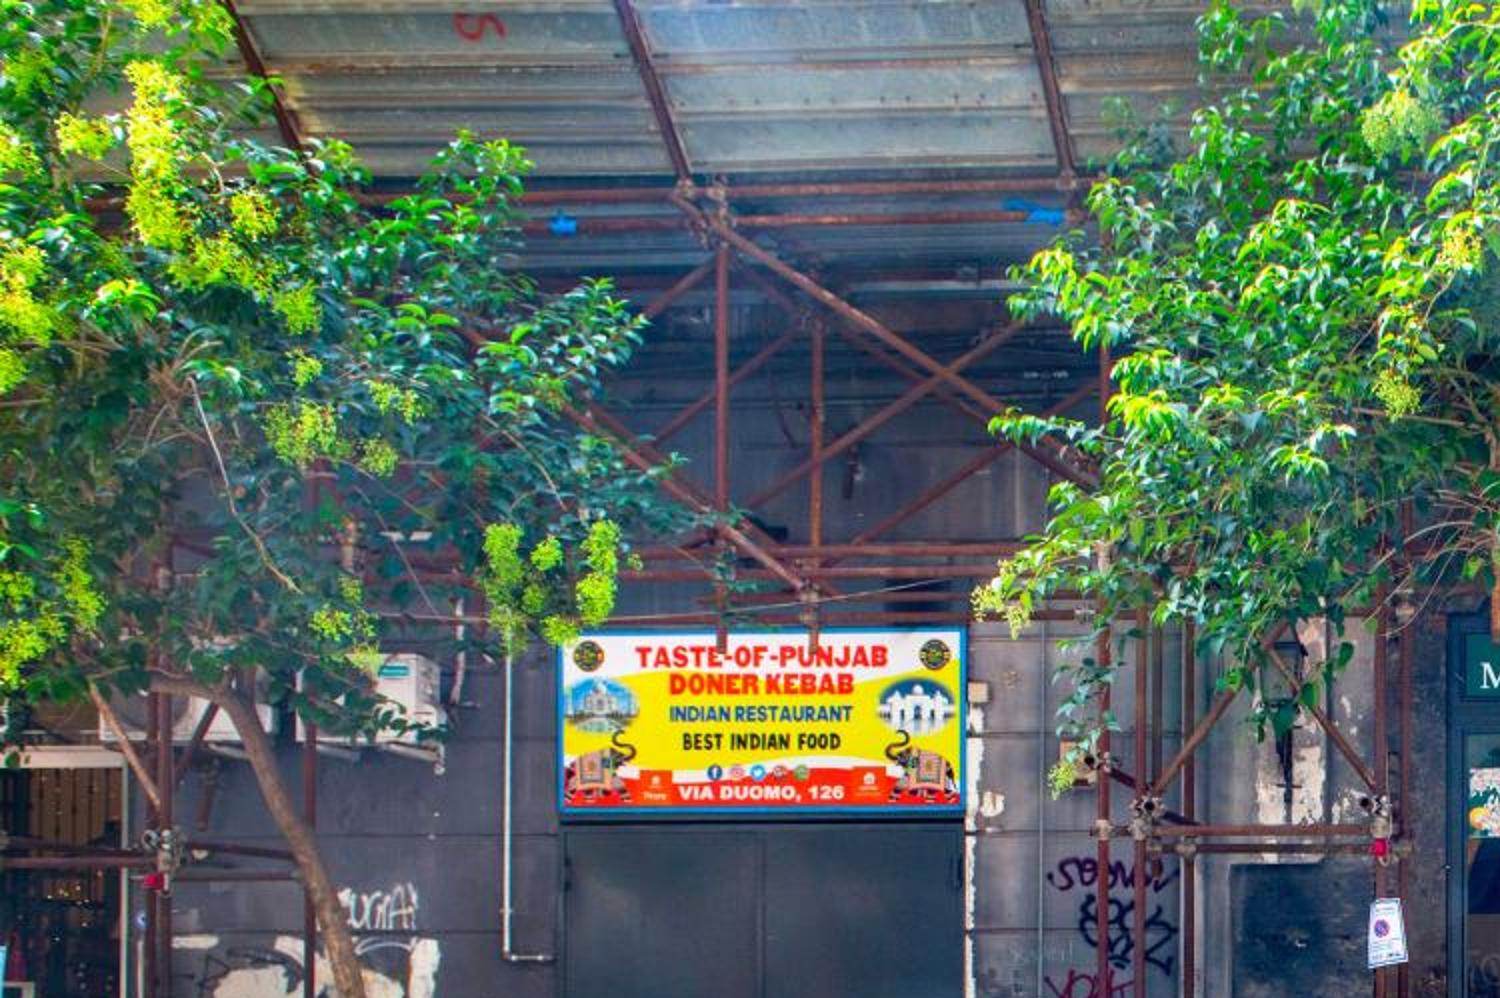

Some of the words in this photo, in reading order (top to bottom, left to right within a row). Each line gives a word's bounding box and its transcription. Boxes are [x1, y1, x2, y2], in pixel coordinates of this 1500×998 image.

[635, 646, 888, 668] TASTE-OF-PUNJAB
[669, 673, 759, 695] DONER
[765, 673, 854, 695] KEBAB
[669, 706, 730, 721] INDIAN
[735, 706, 853, 721] RESTAURANT
[682, 733, 723, 750] BEST
[730, 733, 790, 750] INDIAN
[797, 733, 841, 750] FOOD
[679, 786, 713, 800] VIA
[719, 786, 802, 803] DUOMO,
[808, 785, 845, 800] 126
